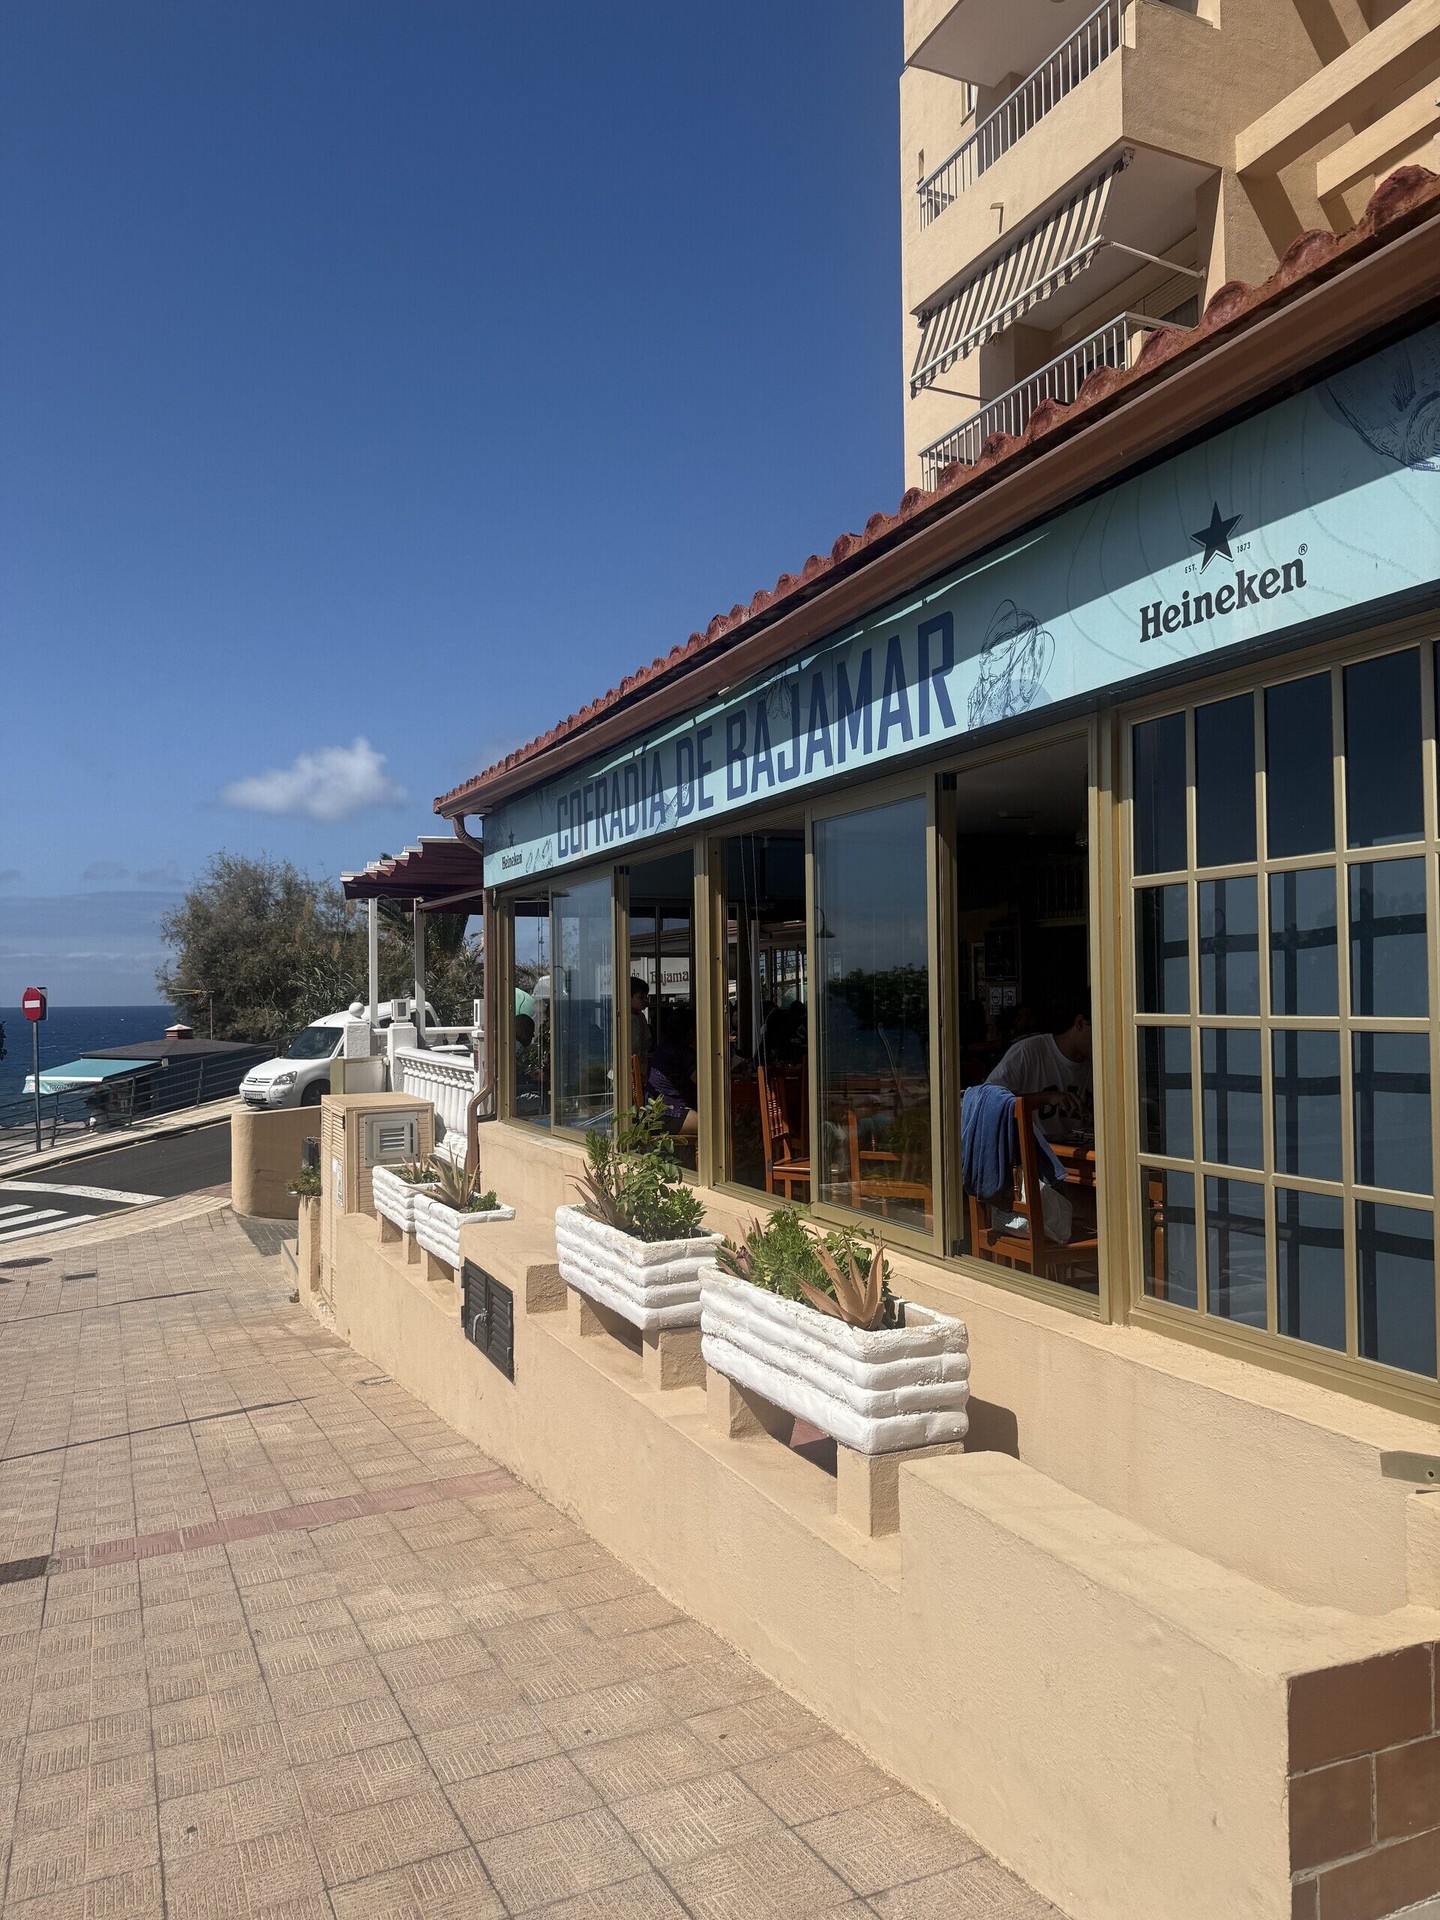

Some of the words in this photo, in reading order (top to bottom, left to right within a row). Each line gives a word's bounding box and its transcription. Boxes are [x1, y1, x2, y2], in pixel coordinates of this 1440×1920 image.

[1184, 563, 1198, 574] EST.
[1236, 541, 1251, 554] 1873
[556, 739, 667, 858] COFRADÍA
[676, 721, 714, 818] DE
[726, 611, 956, 801] BAJAMAR
